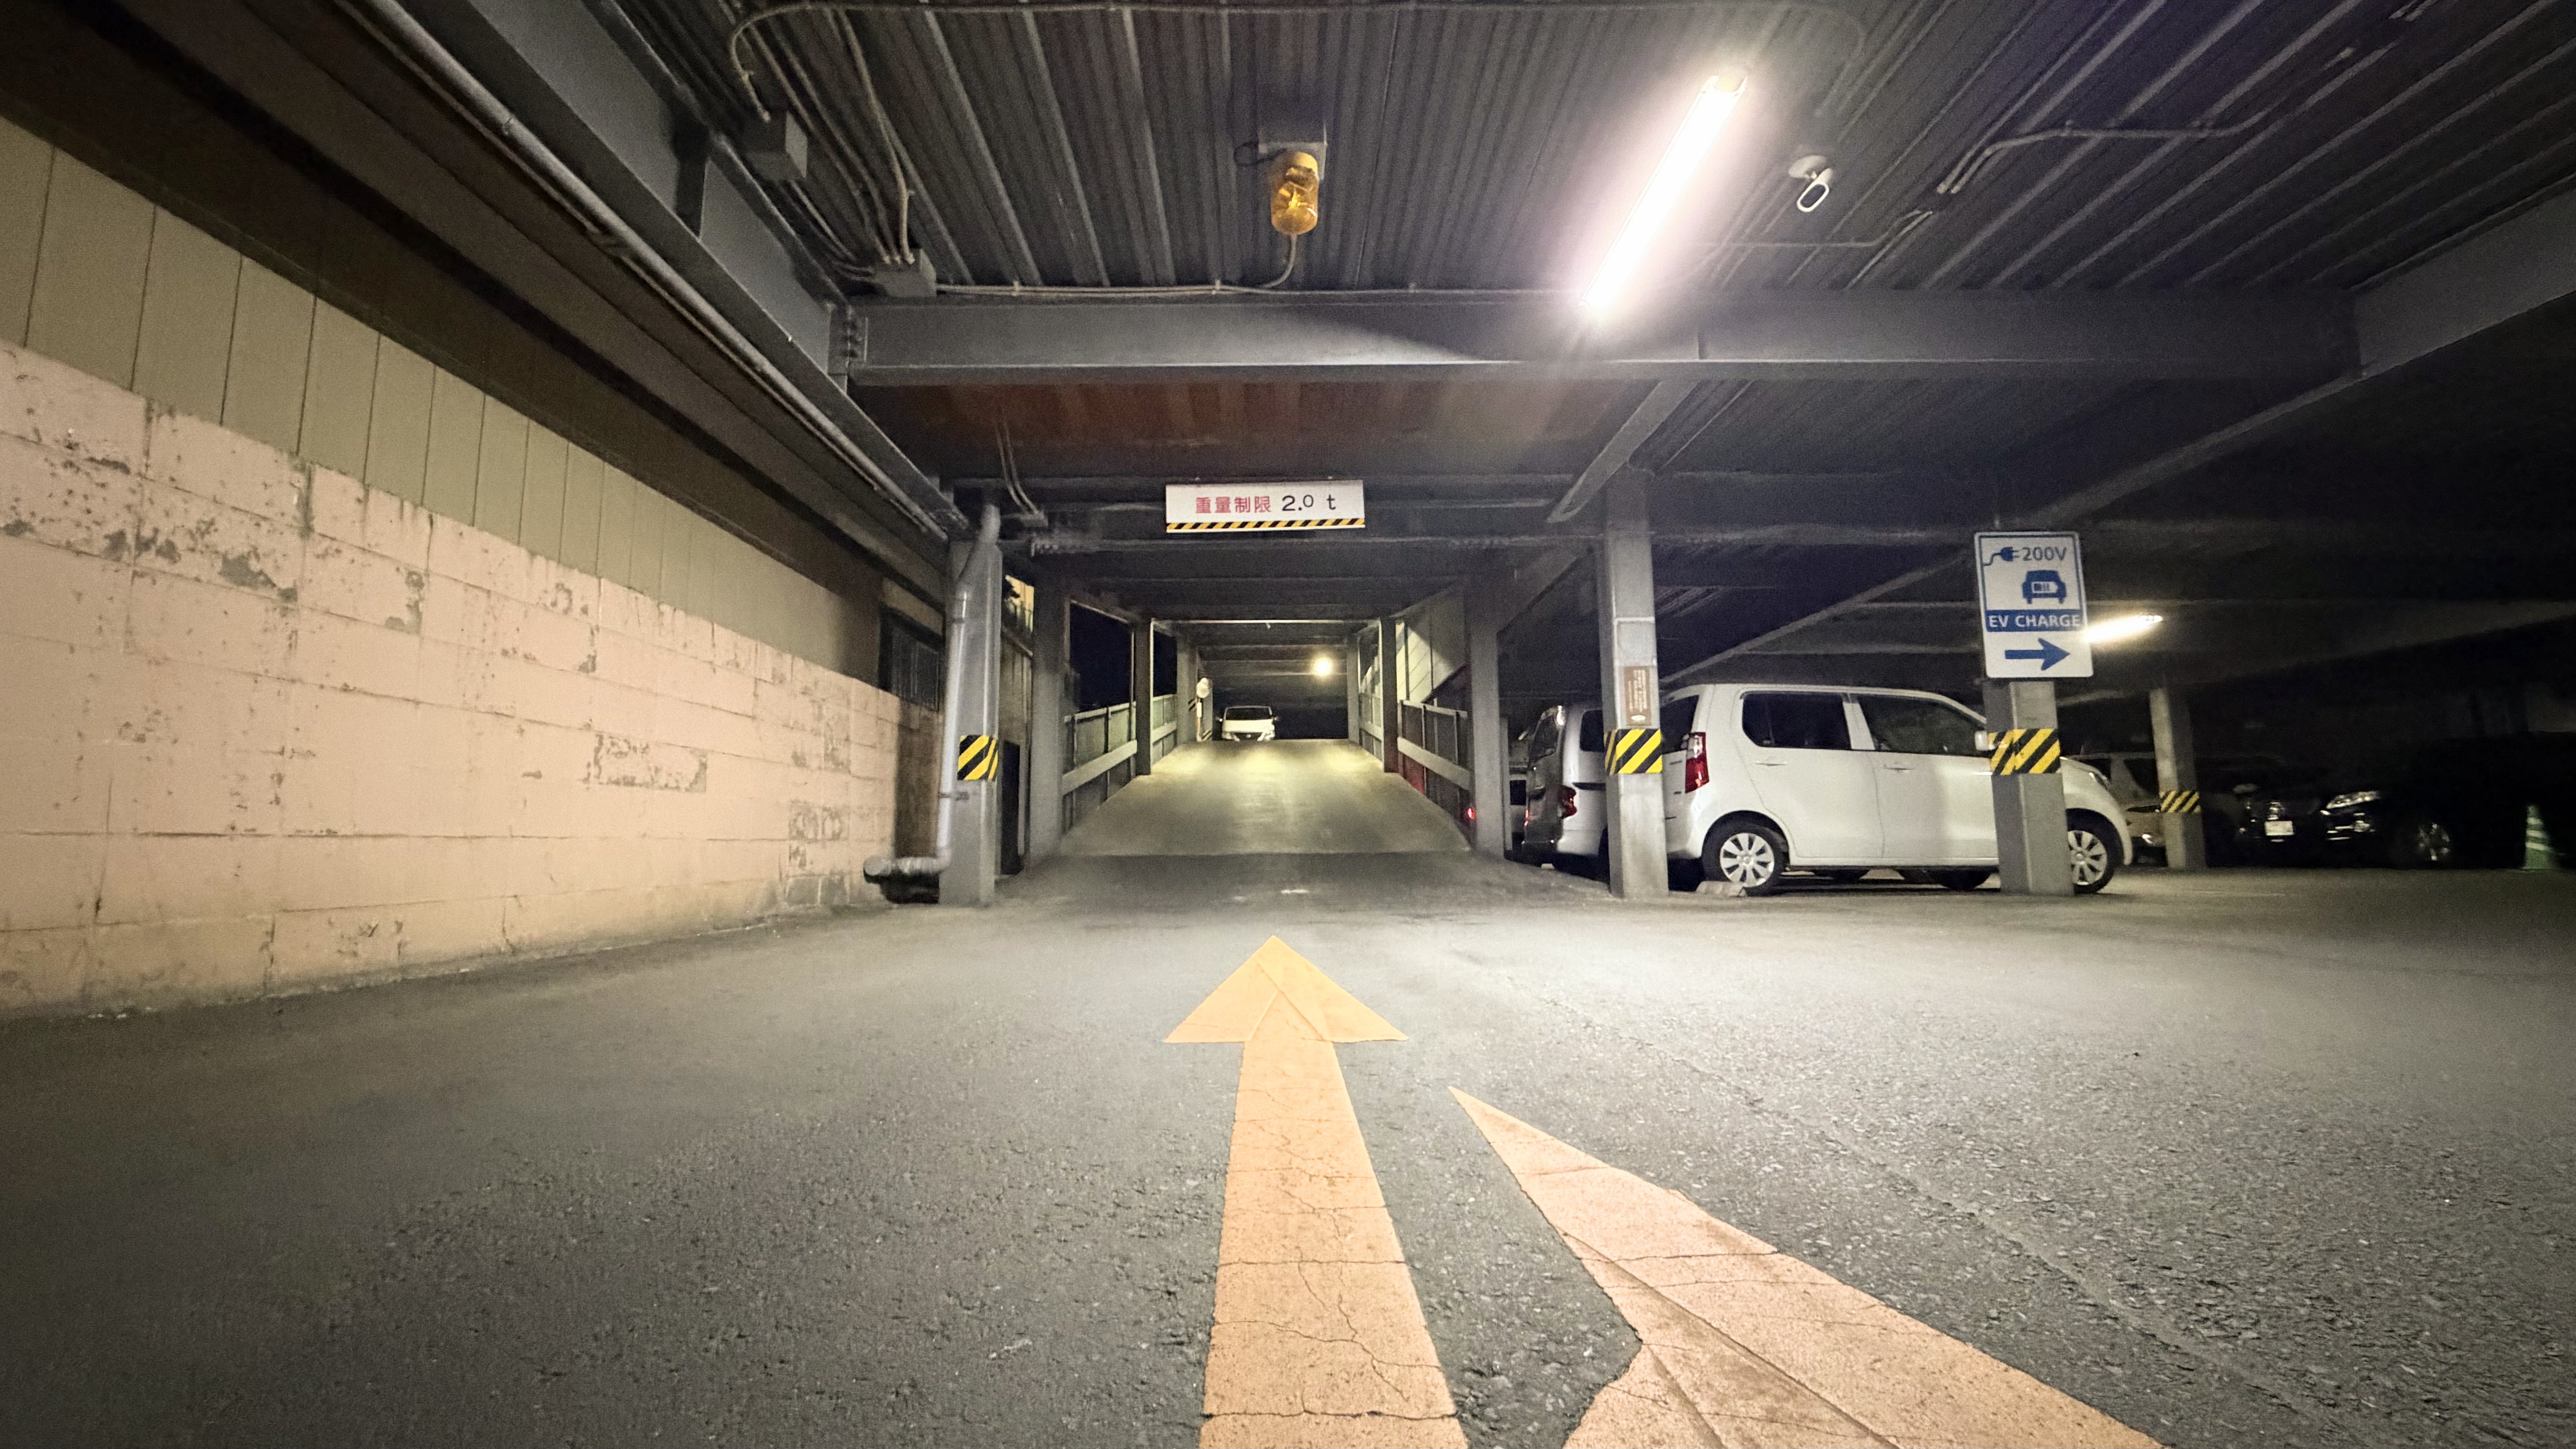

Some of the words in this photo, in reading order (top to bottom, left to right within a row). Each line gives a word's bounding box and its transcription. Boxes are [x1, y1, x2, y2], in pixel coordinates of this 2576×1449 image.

[1196, 496, 1271, 513] 重量制限
[1282, 494, 1314, 511] 2.0
[1326, 494, 1336, 510] t
[2022, 547, 2067, 561] 200V
[1989, 615, 2008, 627] EV
[2015, 614, 2080, 627] CHARGE
